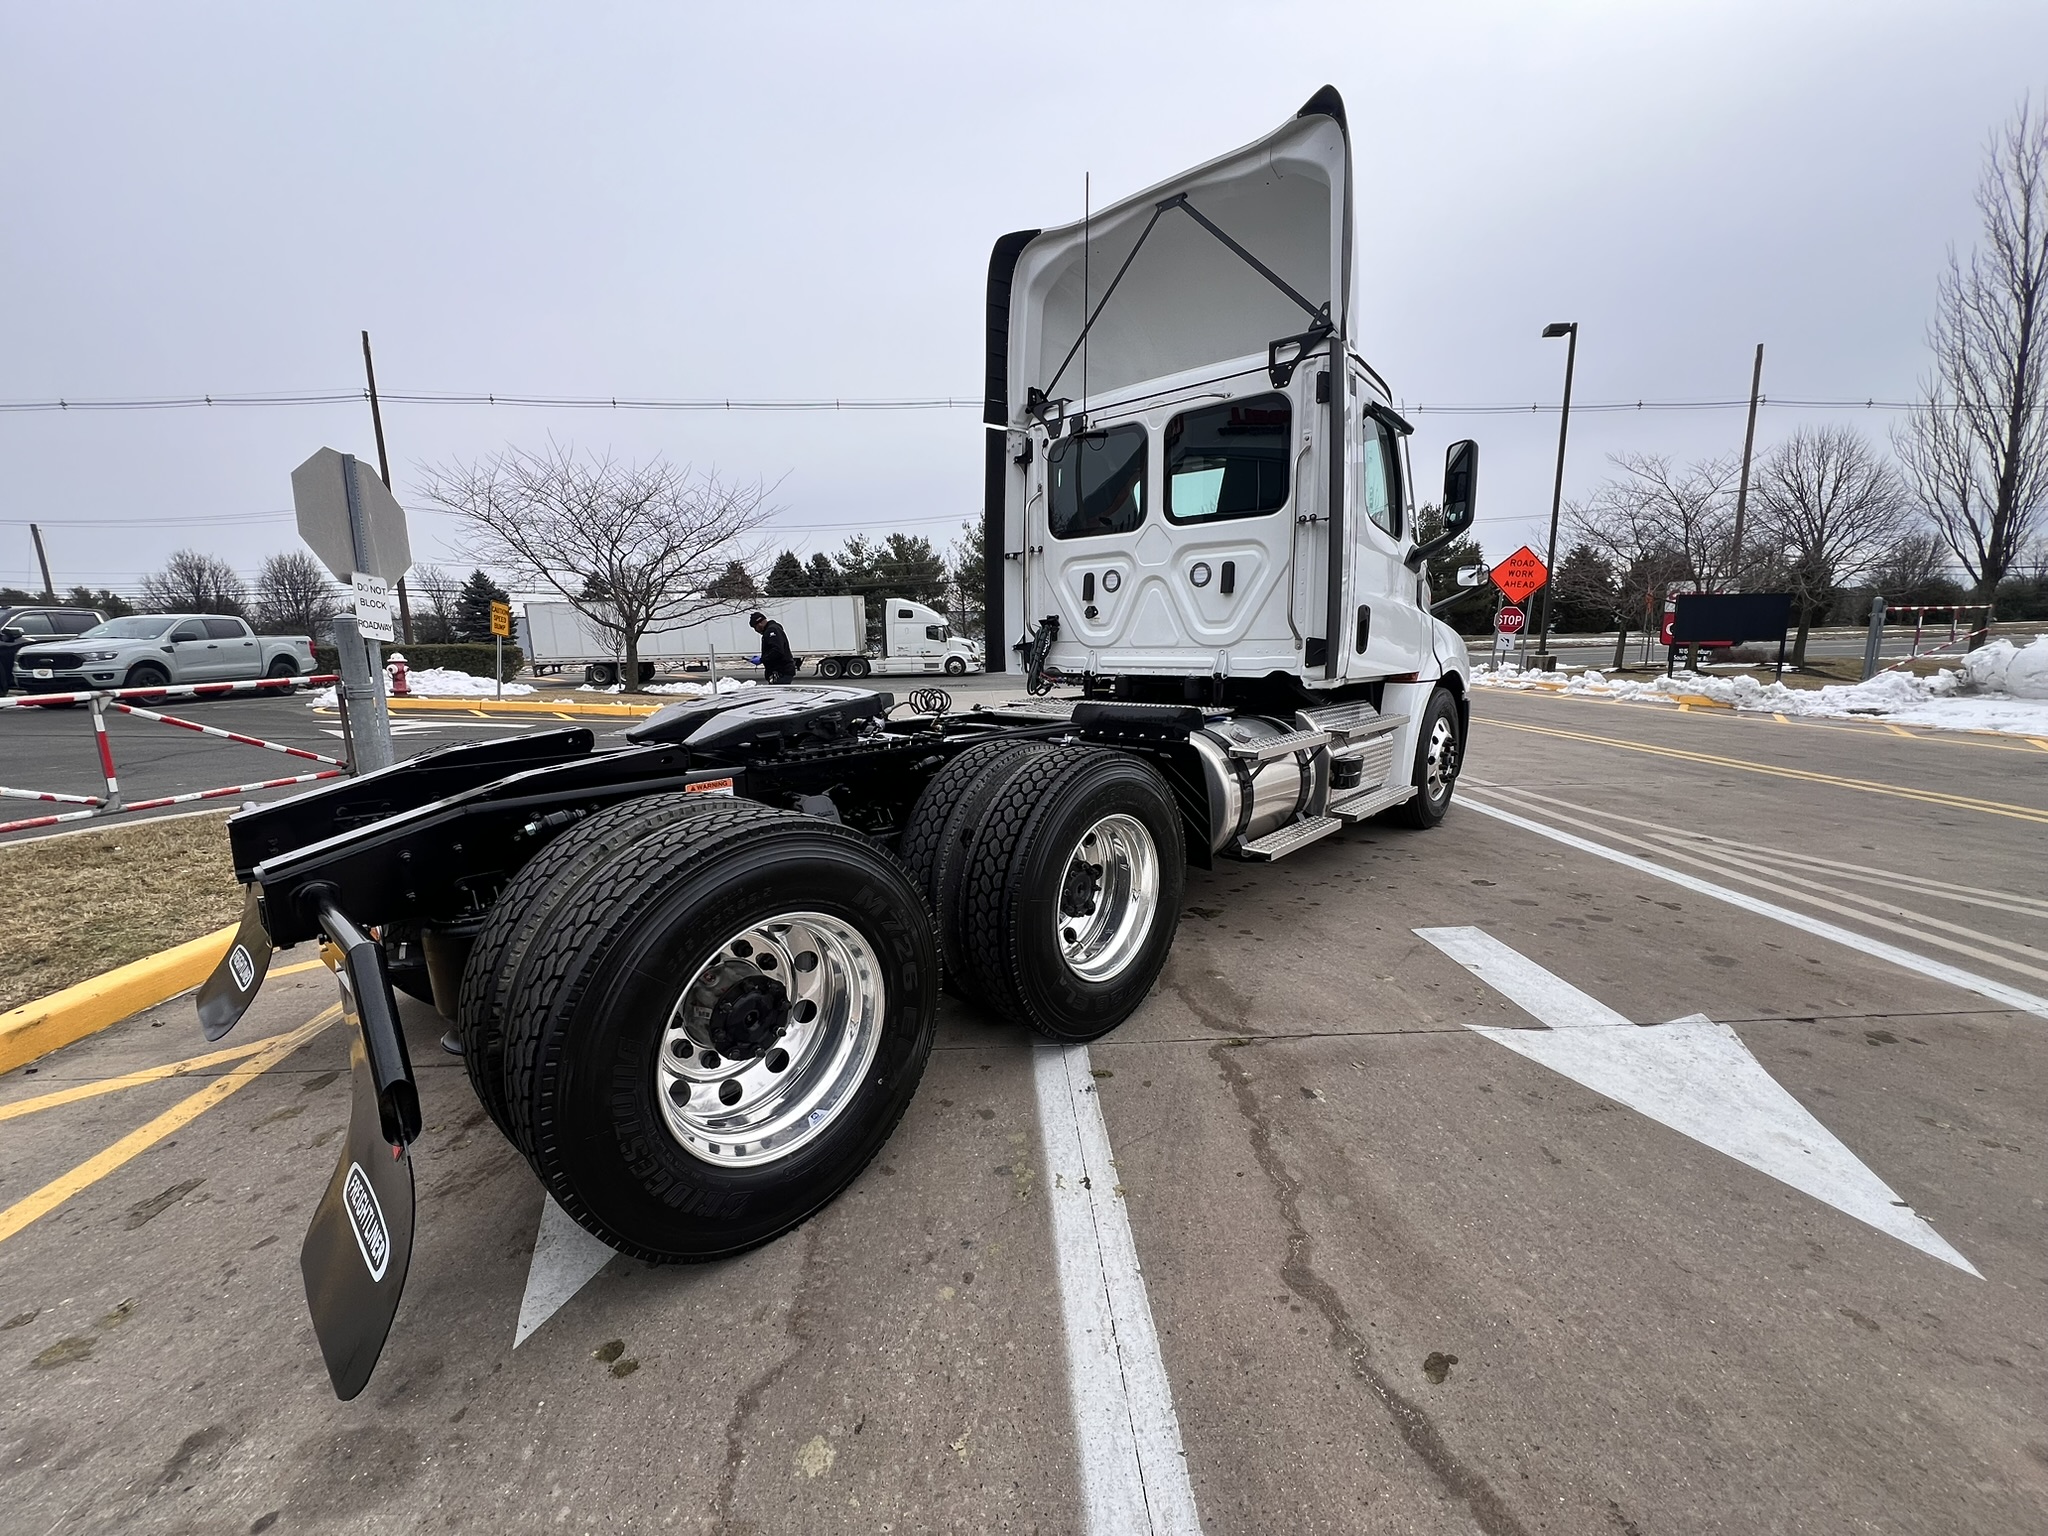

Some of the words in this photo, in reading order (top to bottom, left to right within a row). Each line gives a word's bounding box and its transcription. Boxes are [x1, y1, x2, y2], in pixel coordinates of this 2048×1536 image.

[1509, 559, 1535, 567] ROAD
[1508, 570, 1534, 578] WORK
[357, 582, 369, 592] DO
[370, 585, 386, 595] NOT
[360, 597, 387, 610] BLOCK
[491, 606, 509, 615] CAUTION
[493, 614, 506, 623] SPEED
[1498, 615, 1522, 625] STOP
[358, 619, 393, 631] ROADWAY
[493, 622, 506, 631] BUMP
[697, 780, 728, 790] WARNING
[609, 1035, 755, 1221] BRIDGESTONE
[347, 1174, 387, 1266] FREIGHTLINER
